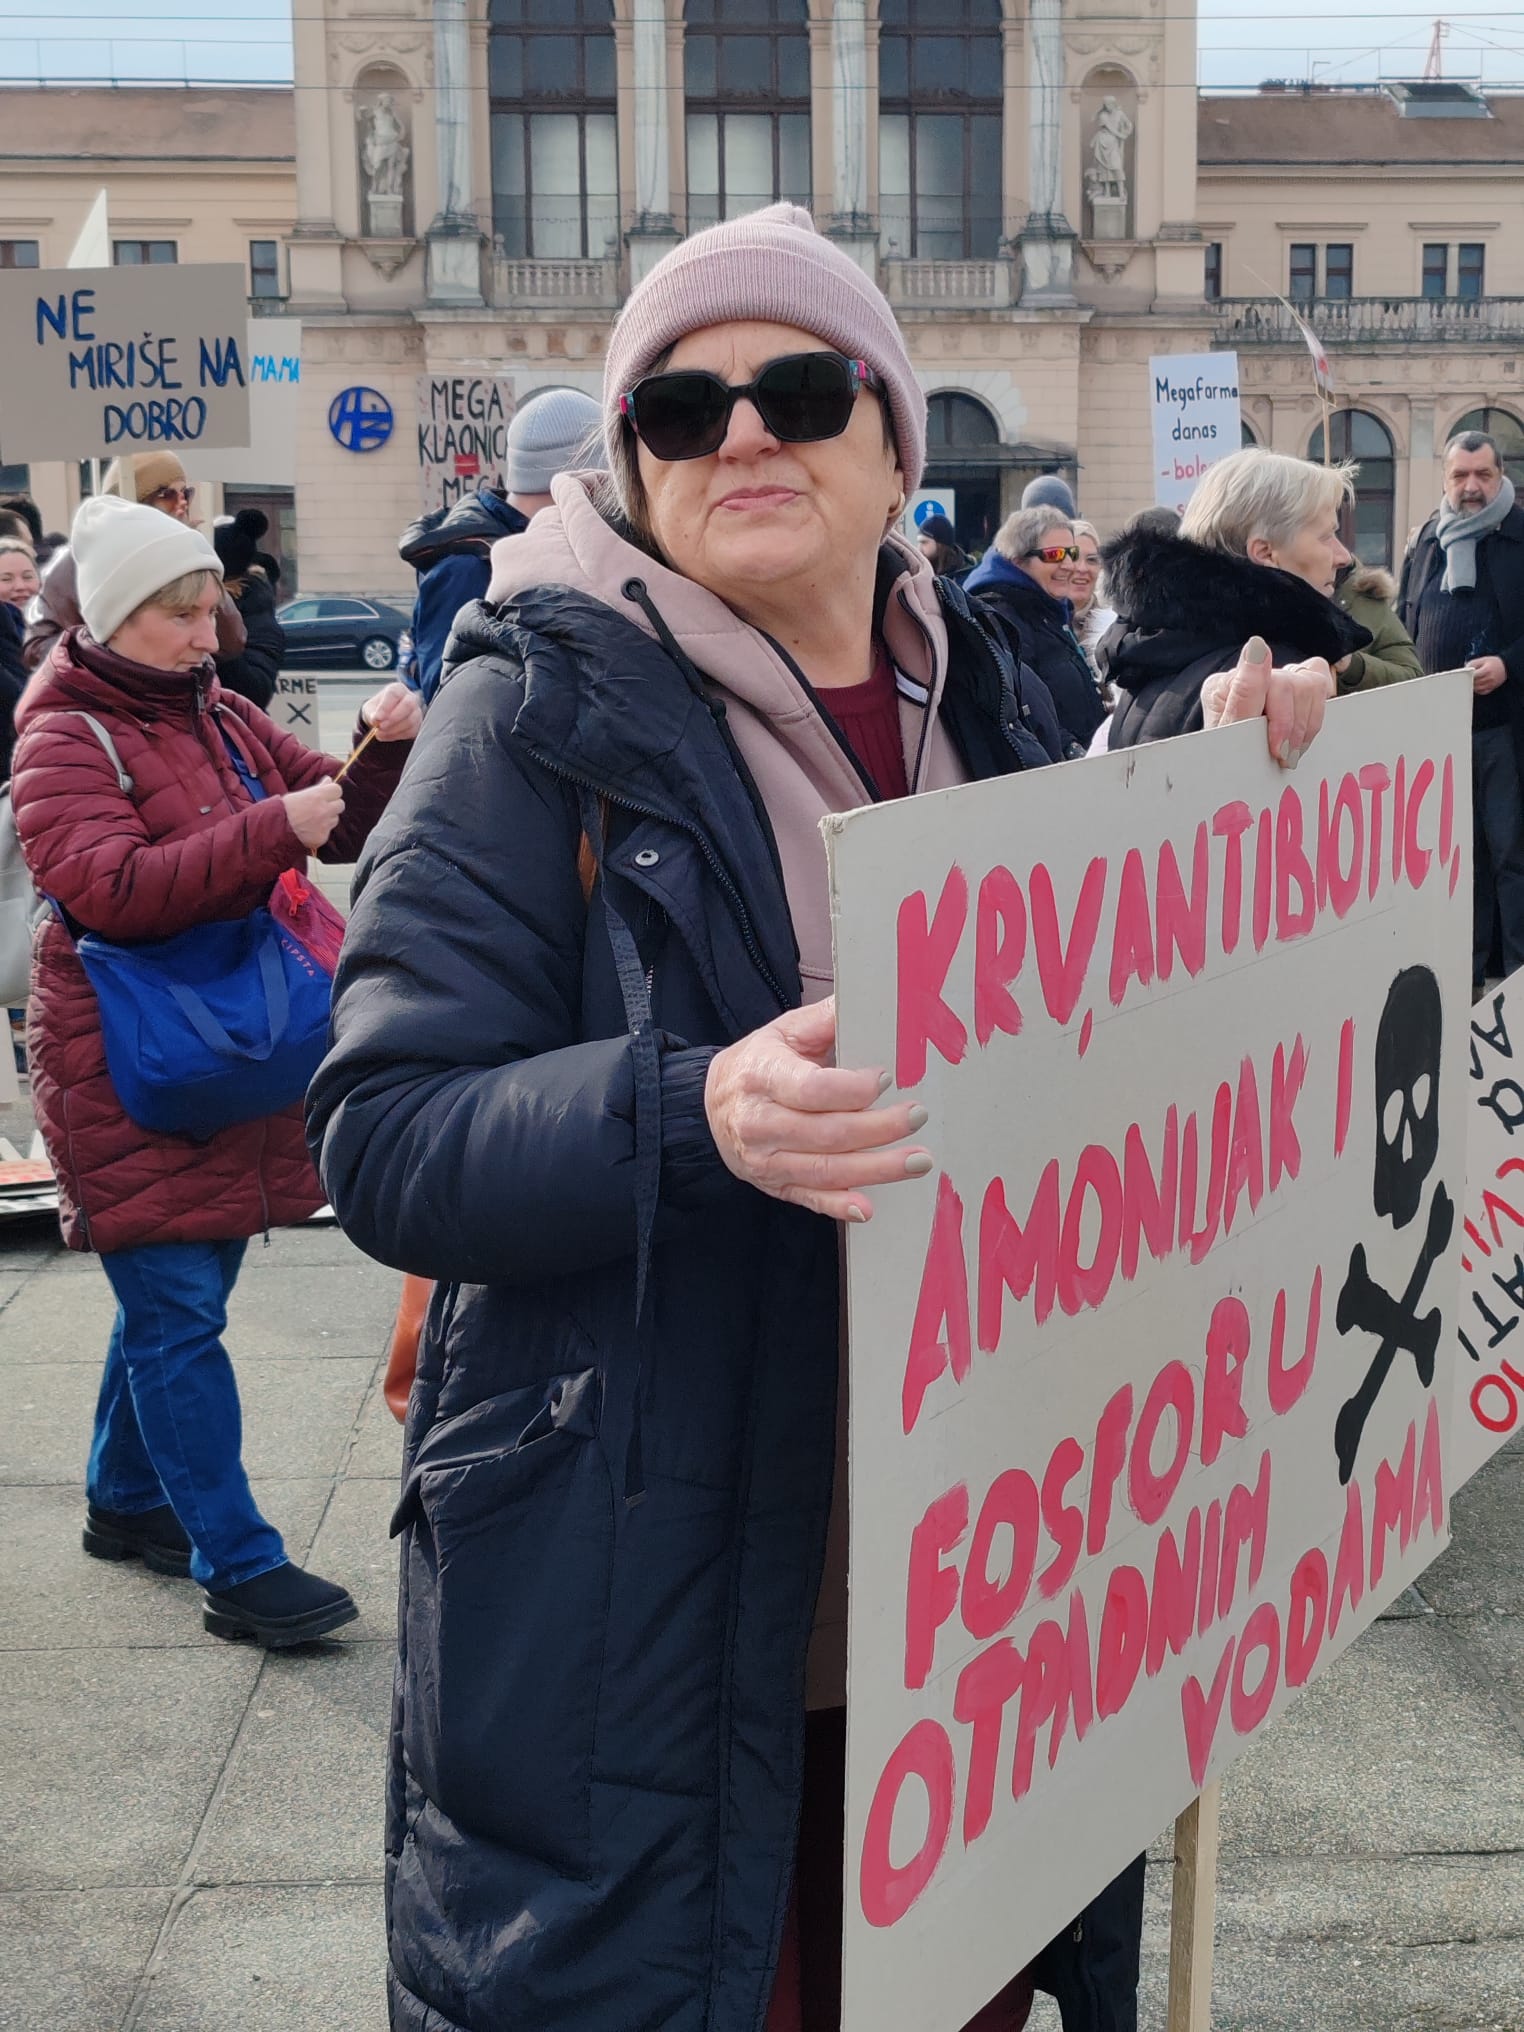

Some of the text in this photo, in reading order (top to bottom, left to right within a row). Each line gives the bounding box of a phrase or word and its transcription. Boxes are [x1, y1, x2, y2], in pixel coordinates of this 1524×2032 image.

[36, 289, 96, 346] NE
[68, 331, 247, 390] MIRIŠE NA
[103, 395, 208, 444] DOBRO
[430, 378, 504, 423] MEGA
[1172, 417, 1218, 441] danas
[418, 423, 508, 467] KLAONIC
[275, 678, 317, 695] RME
[895, 755, 1461, 1089] KRV, ANTIBIOTICI,
[901, 1032, 1310, 1434] AMONIJAK
[1334, 1017, 1355, 1158] I
[1181, 1396, 1444, 1788] VODAMA
[860, 1449, 1272, 1928] OTPADNIM
